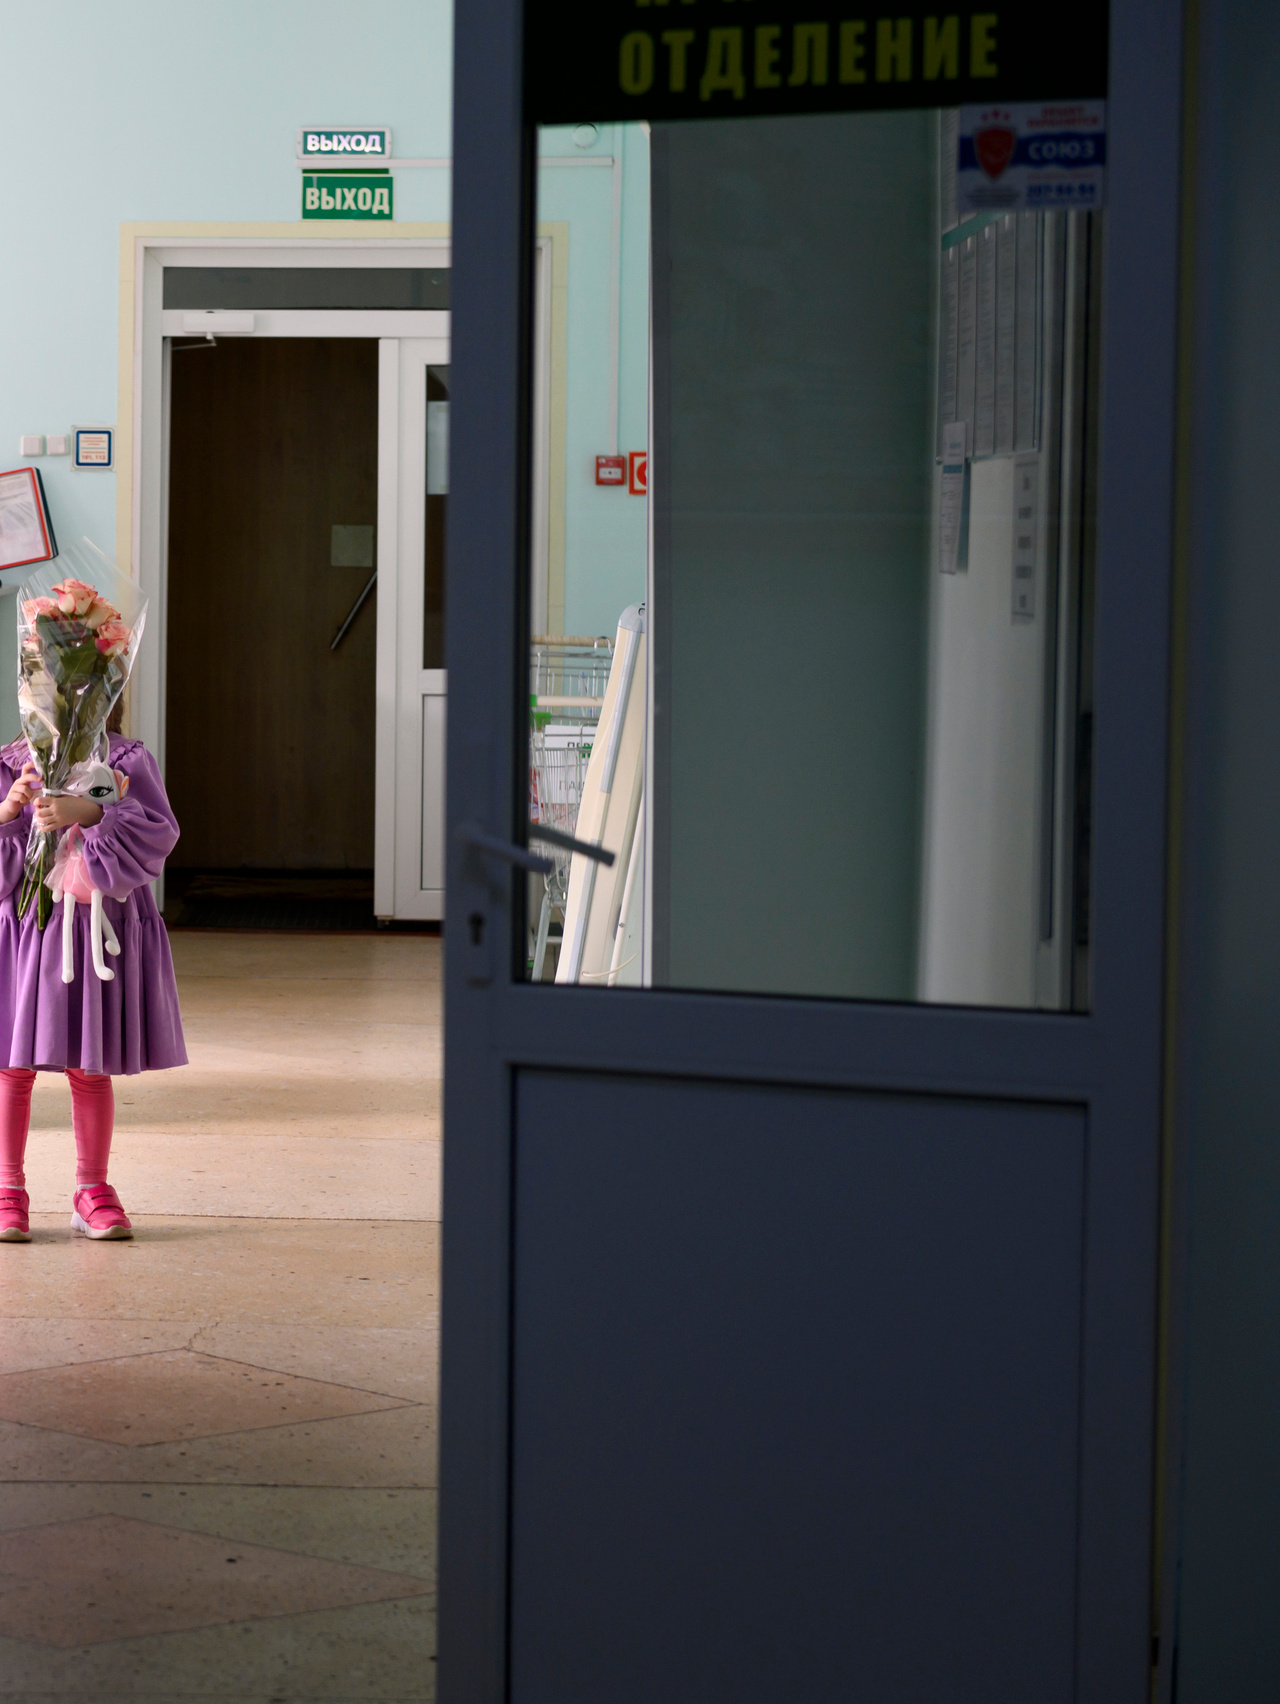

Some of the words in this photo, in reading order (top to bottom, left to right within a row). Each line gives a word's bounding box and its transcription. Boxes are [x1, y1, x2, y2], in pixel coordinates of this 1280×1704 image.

[619, 13, 999, 101] ОТДЕЛЕНИЕ
[306, 134, 382, 153] ВЫХОД
[1027, 138, 1096, 161] СОЮЗ
[305, 187, 390, 215] ВЫХОД
